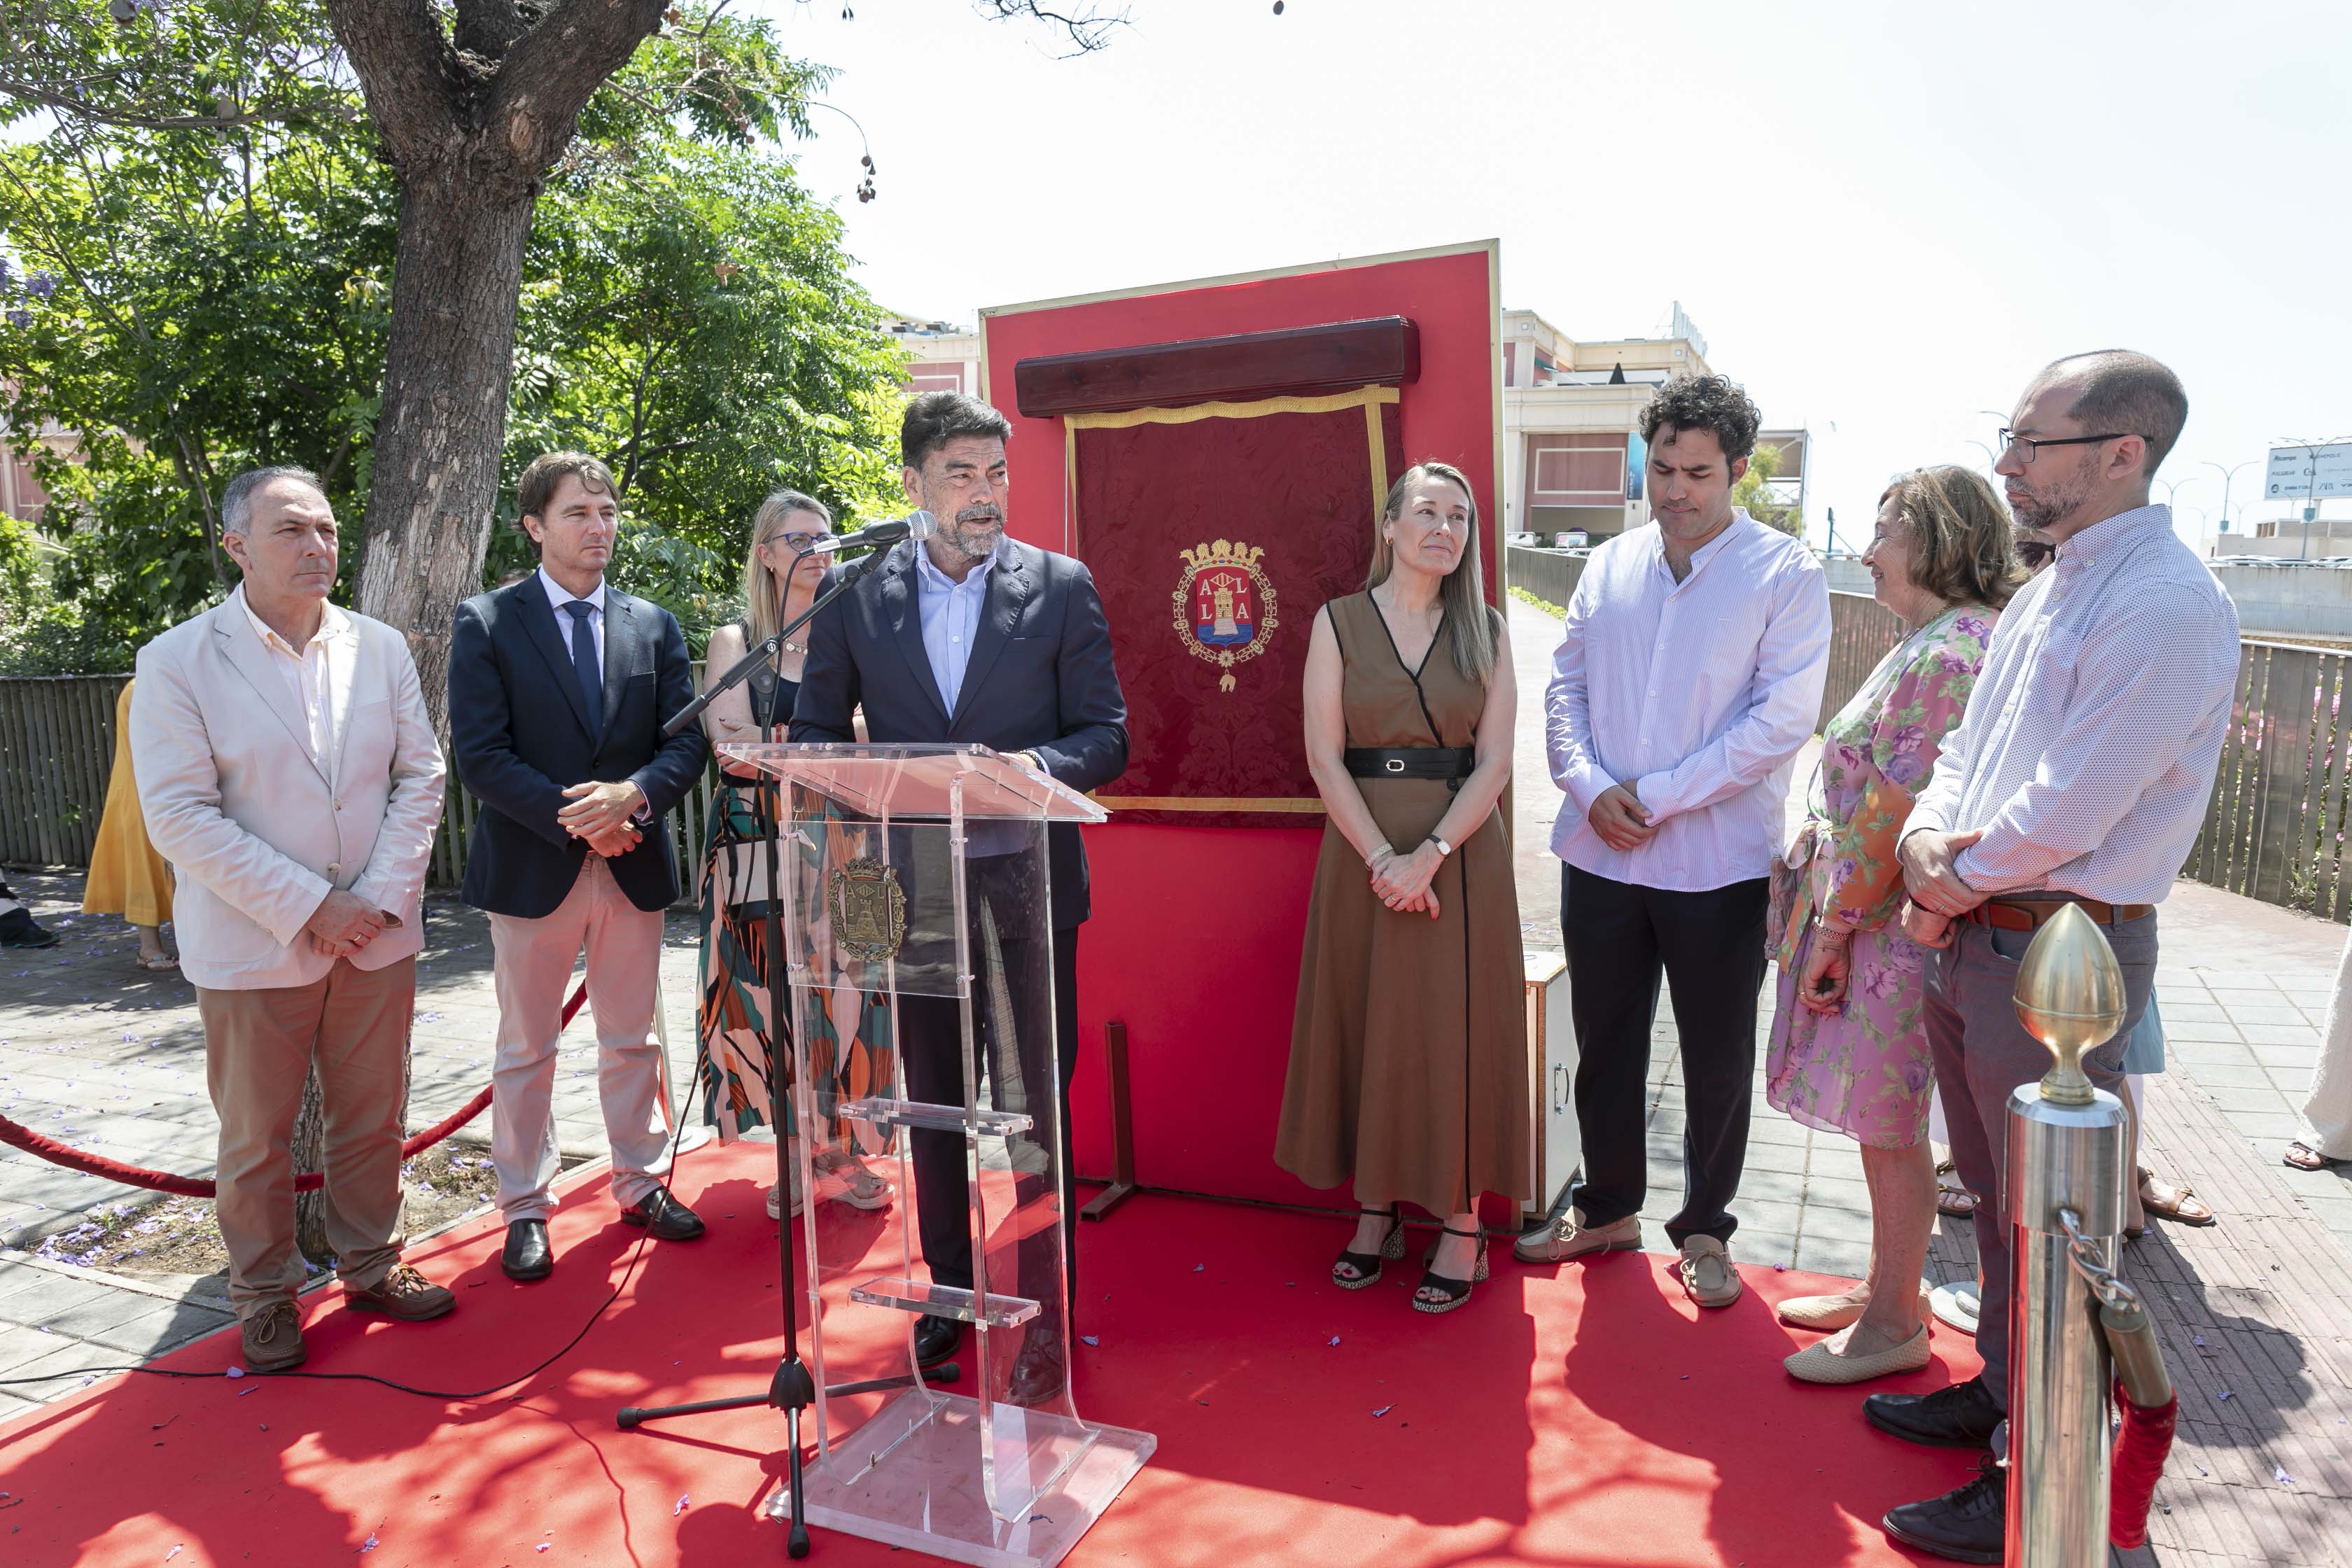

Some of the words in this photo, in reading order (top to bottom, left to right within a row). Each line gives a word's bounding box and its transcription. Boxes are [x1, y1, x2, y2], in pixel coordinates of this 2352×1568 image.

[1200, 578, 1212, 596] A
[1236, 578, 1247, 594] L
[1201, 604, 1212, 620] L
[1236, 603, 1249, 620] A
[846, 884, 856, 898] A
[877, 886, 885, 899] L
[847, 904, 854, 916] L
[876, 906, 886, 918] A
